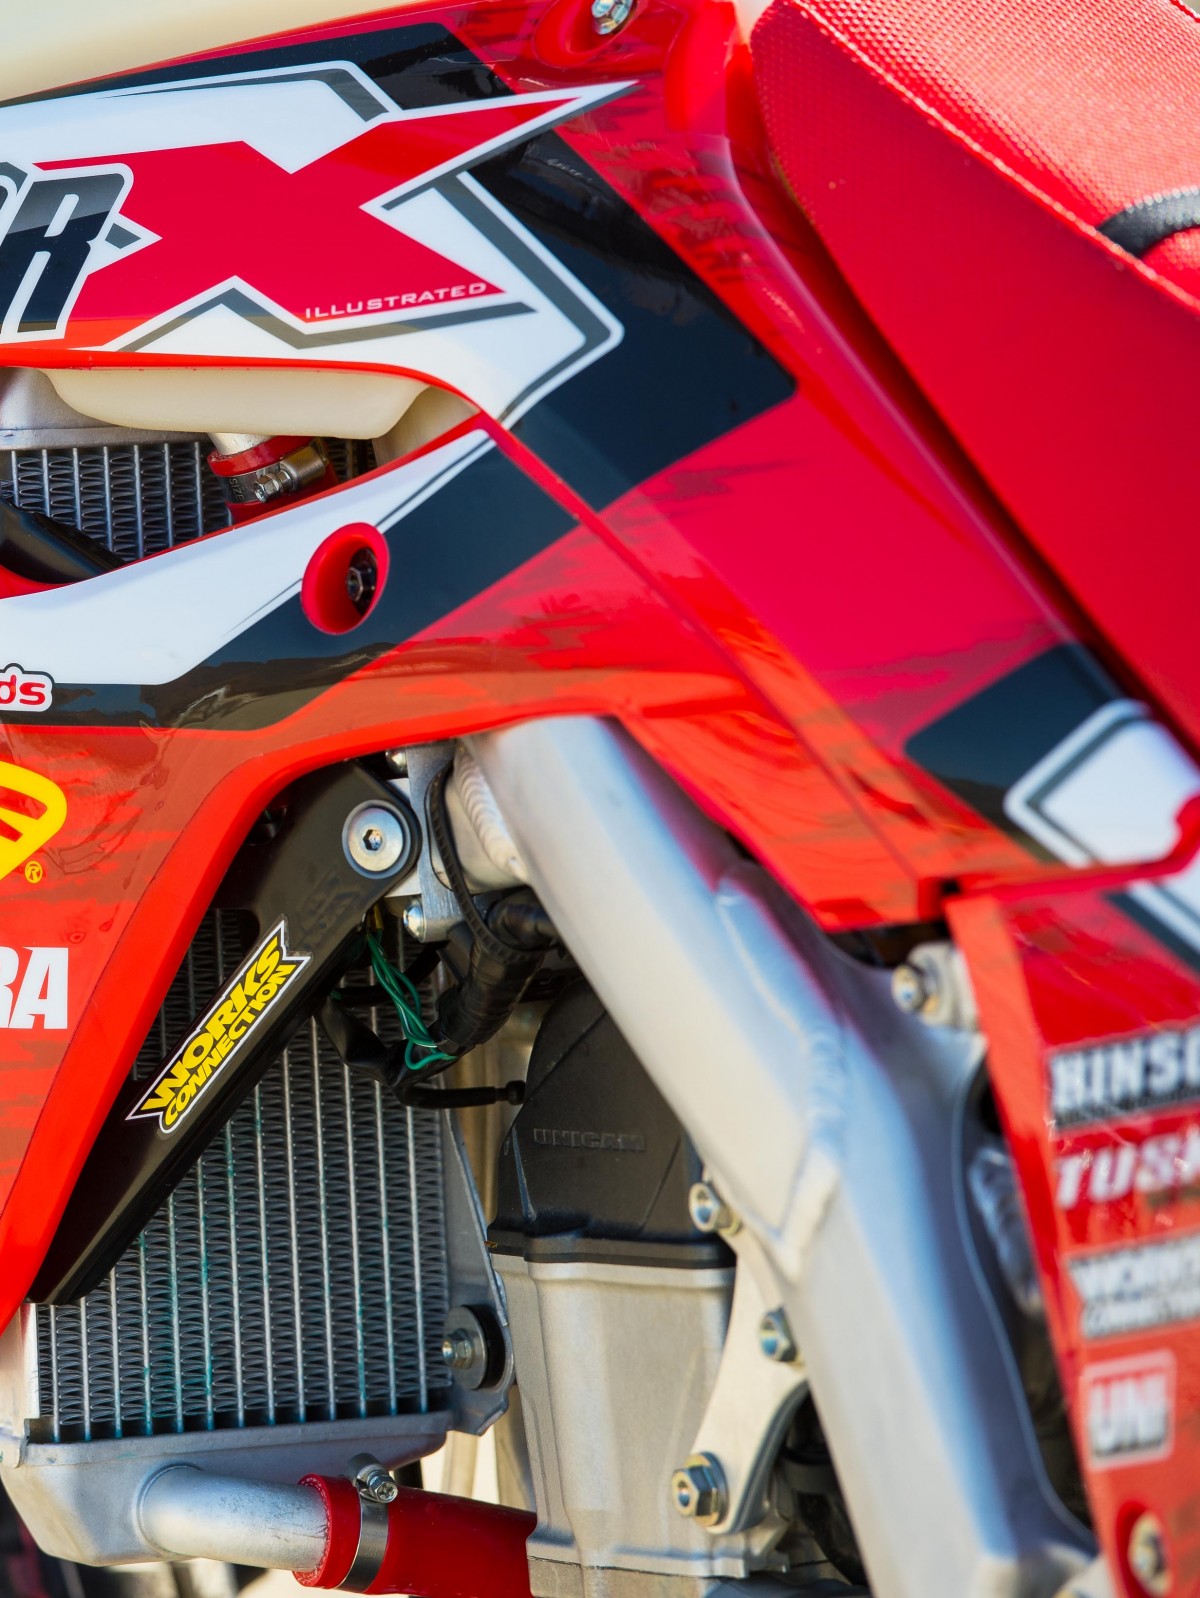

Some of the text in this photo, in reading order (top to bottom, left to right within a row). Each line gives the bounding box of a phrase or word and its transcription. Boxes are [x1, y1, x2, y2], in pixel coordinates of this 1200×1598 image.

[305, 281, 488, 319] ILLUSTRATED
[140, 935, 280, 1112] WORKS
[164, 963, 297, 1127] CONNECTION
